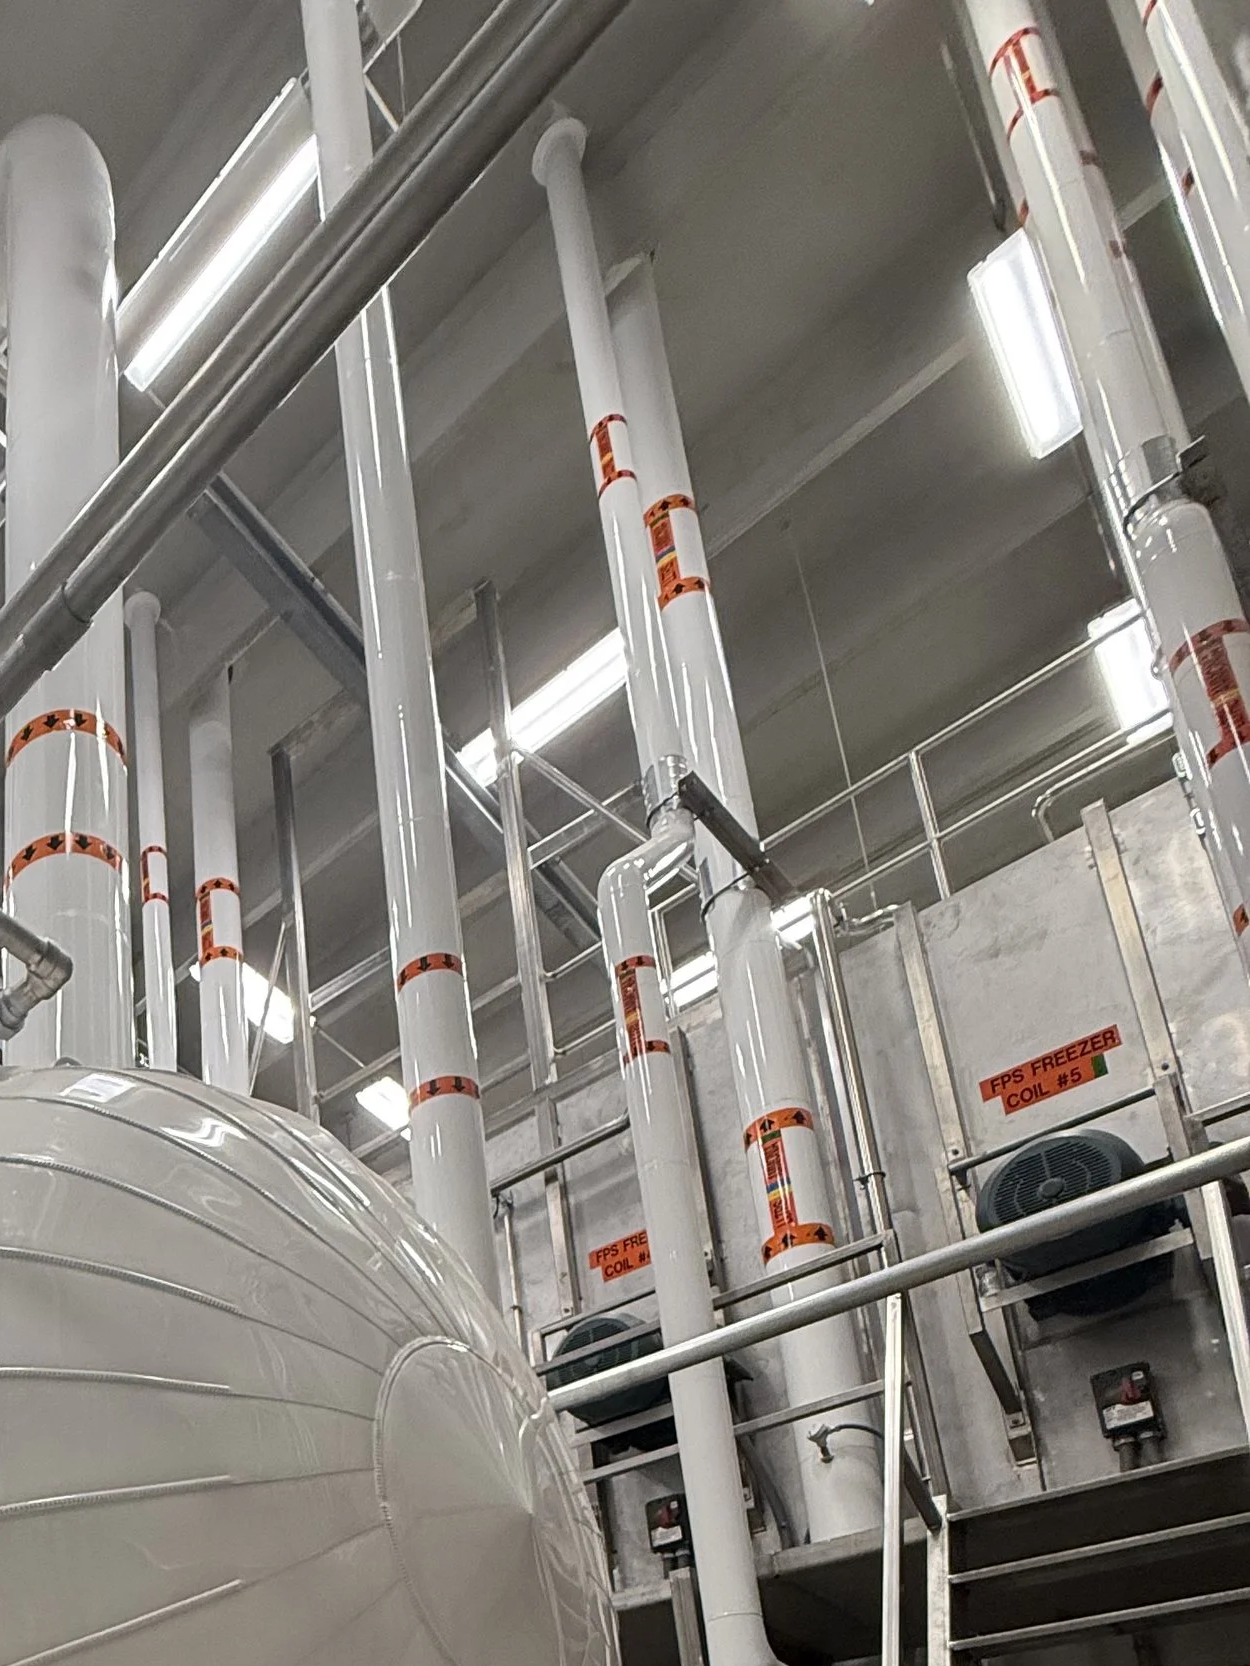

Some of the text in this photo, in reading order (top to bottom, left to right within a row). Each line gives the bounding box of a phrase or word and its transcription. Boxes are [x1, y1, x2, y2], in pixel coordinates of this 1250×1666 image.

[990, 1029, 1117, 1095] FPS FREEZER
[1006, 1066, 1082, 1109] COIL #5
[596, 1244, 619, 1264] FPS
[605, 1257, 634, 1278] COIL
